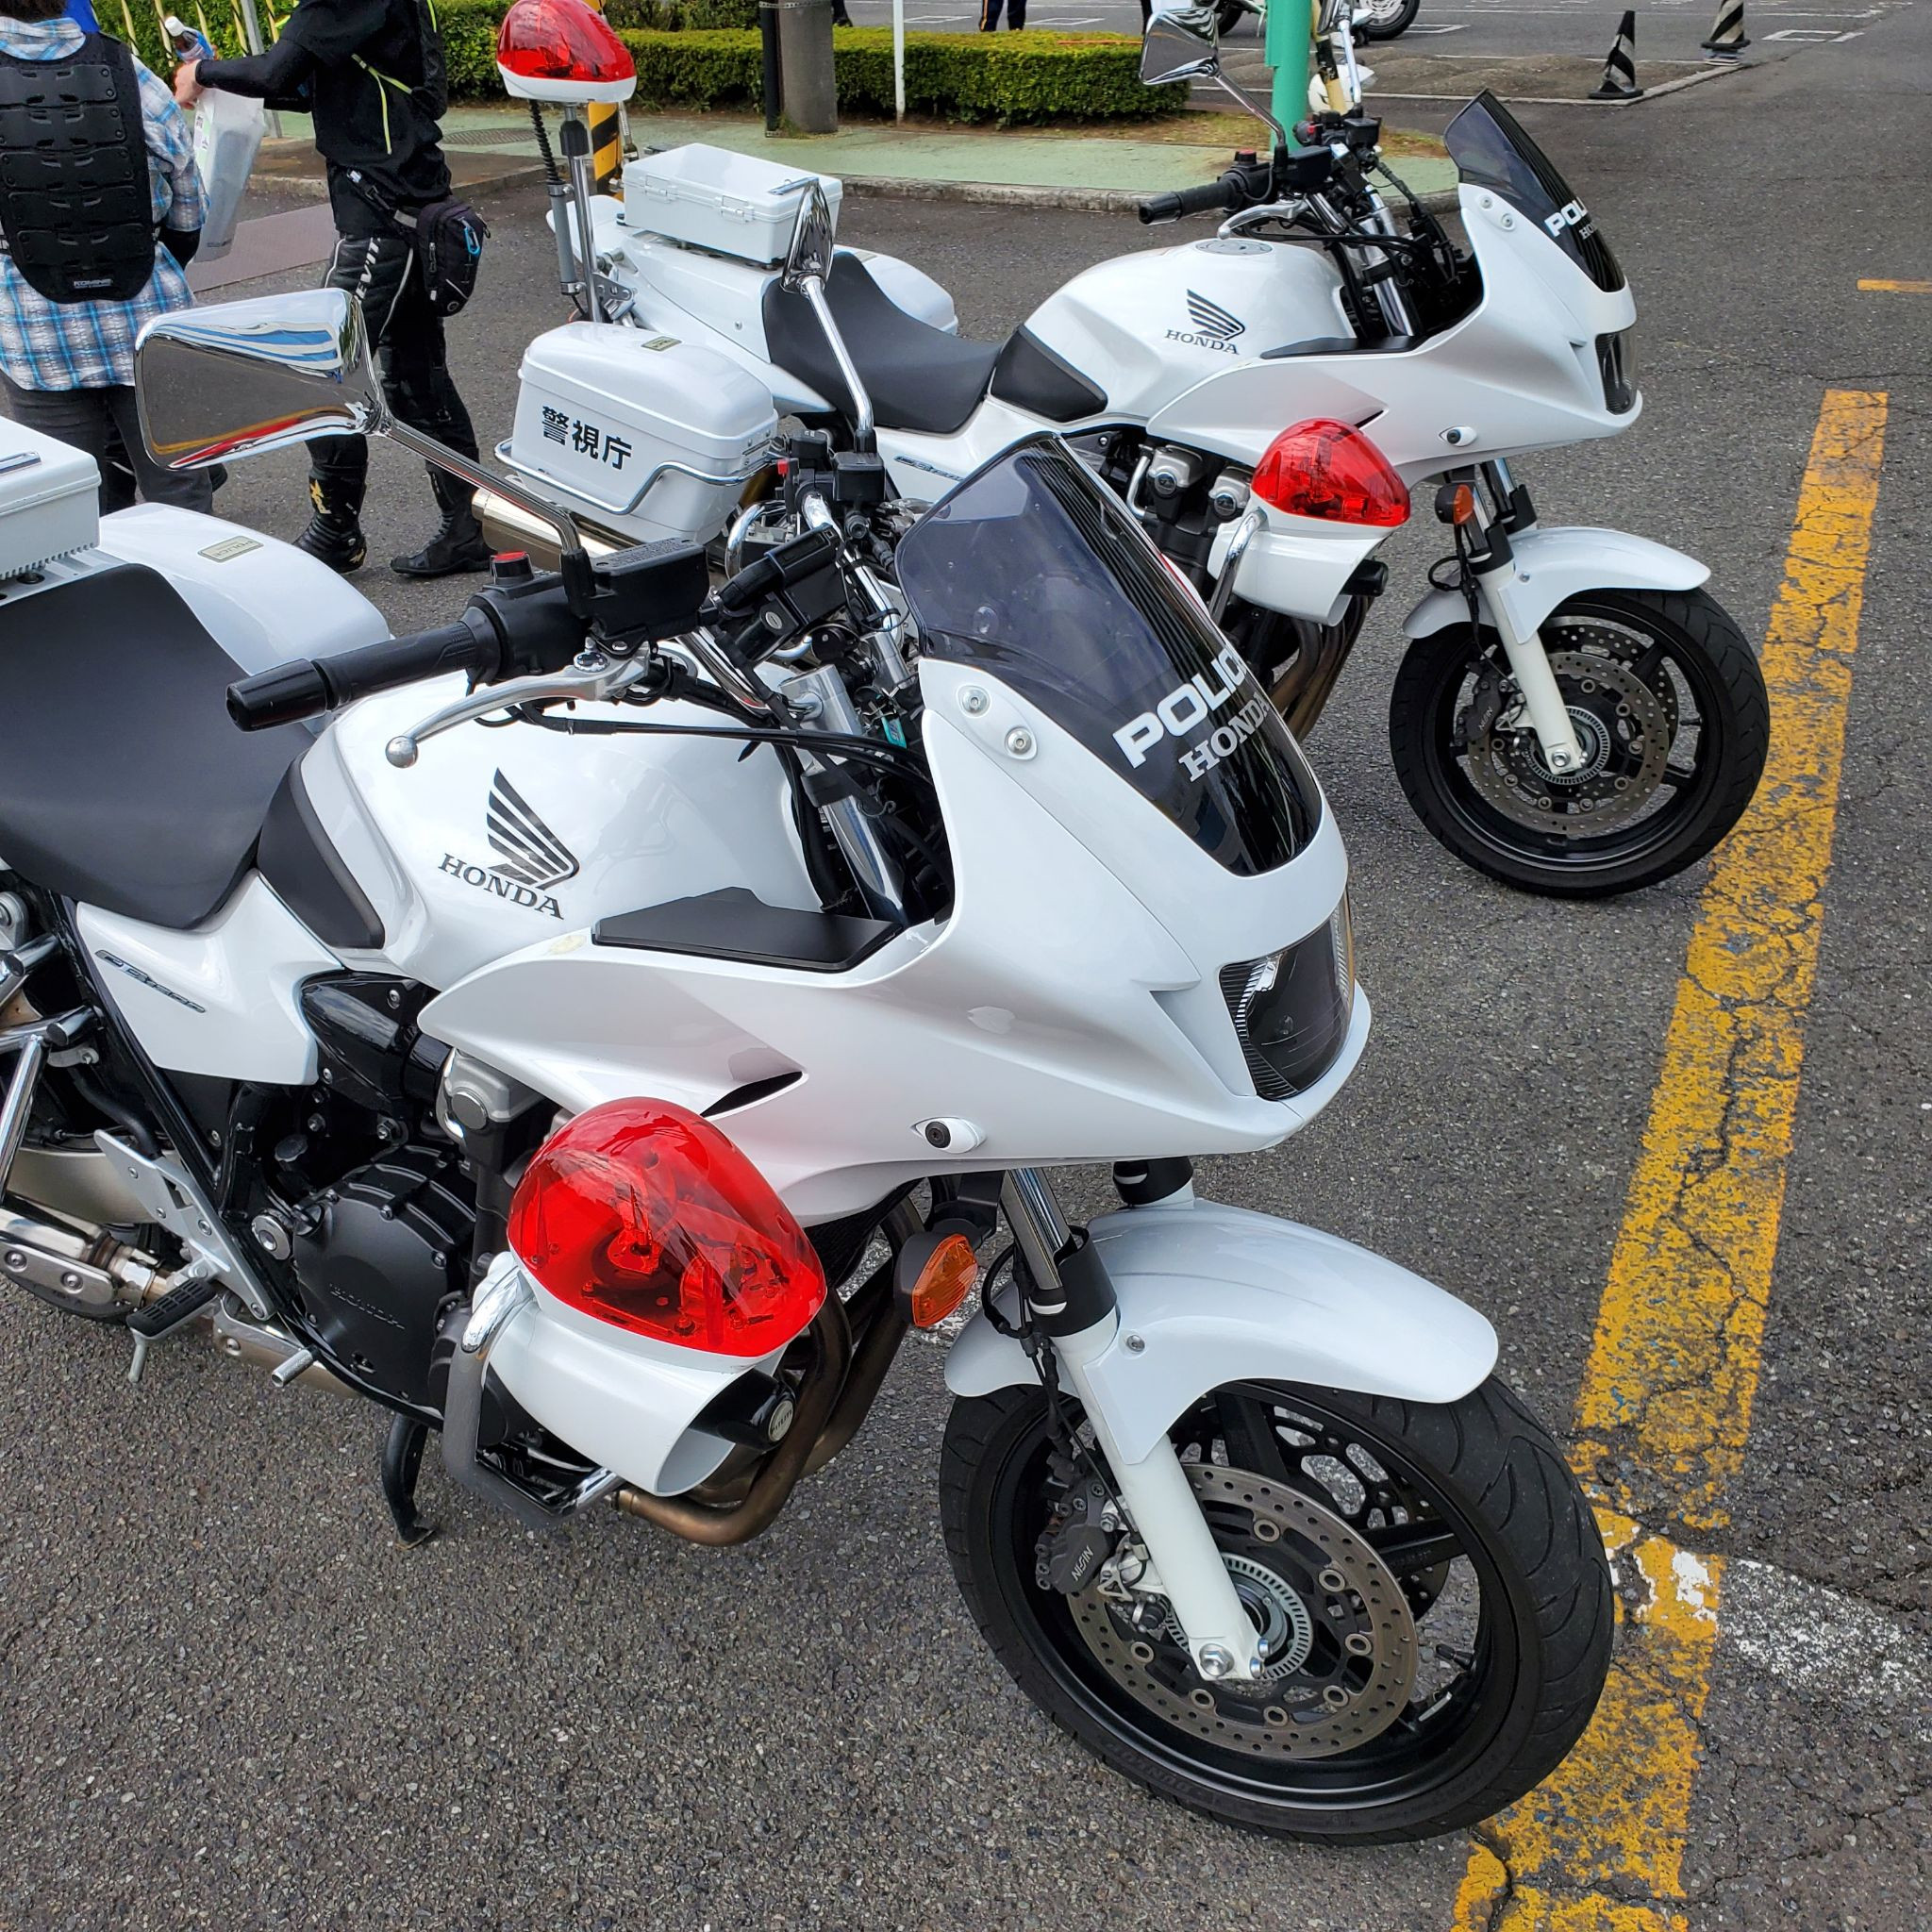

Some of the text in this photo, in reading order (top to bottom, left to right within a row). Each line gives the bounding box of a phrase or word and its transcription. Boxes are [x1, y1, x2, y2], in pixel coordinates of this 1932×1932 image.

[1164, 329, 1240, 355] HONDA
[541, 406, 632, 470] 警視庁
[1112, 648, 1247, 769] POLIC
[1178, 691, 1270, 783] HONDA
[438, 853, 564, 920] HONDA
